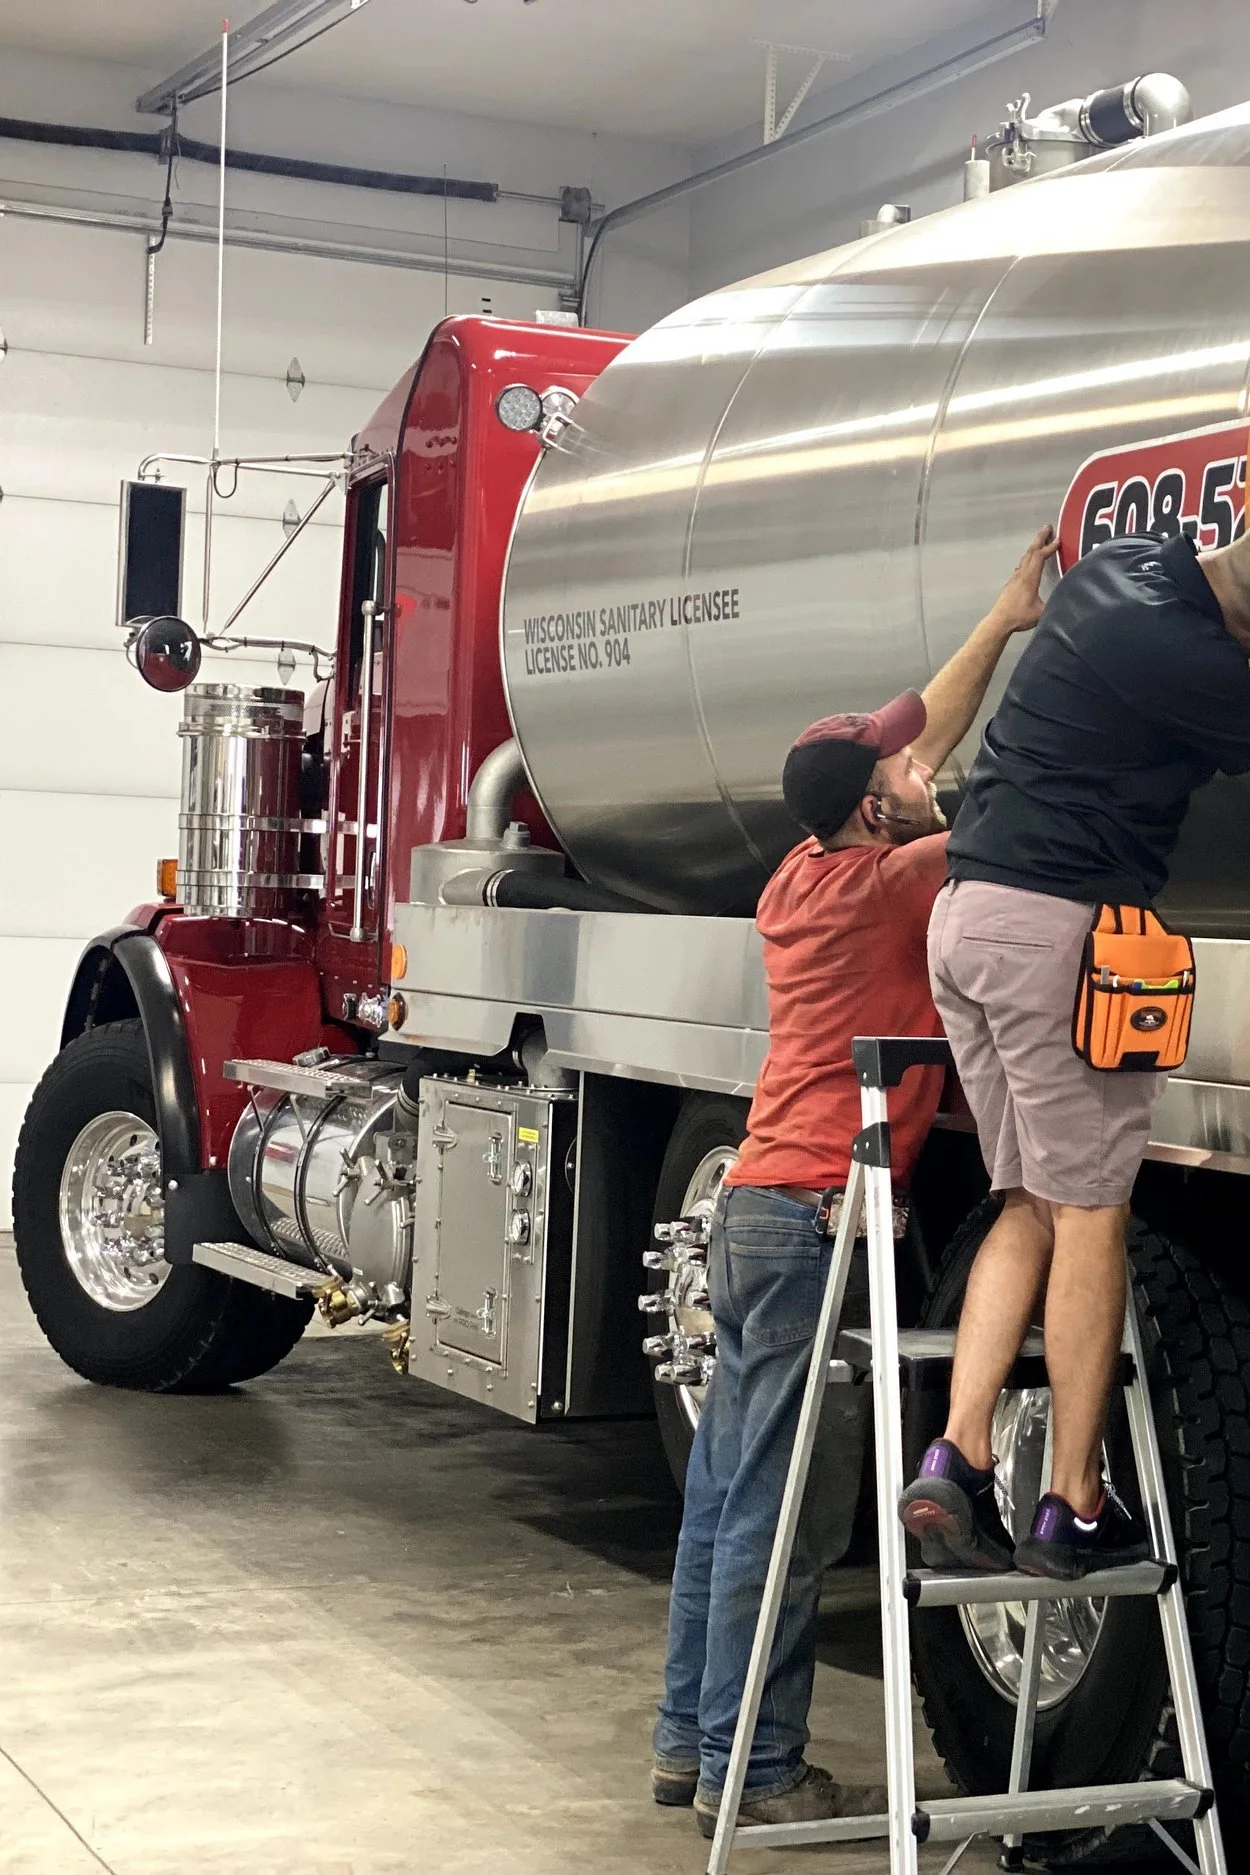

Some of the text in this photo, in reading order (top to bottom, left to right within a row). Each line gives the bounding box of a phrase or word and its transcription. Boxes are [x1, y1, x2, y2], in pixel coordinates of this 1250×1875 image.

[524, 588, 740, 644] WISCONSIN SANITARY LICENSEE
[525, 637, 631, 675] LICENSE NO. 904
